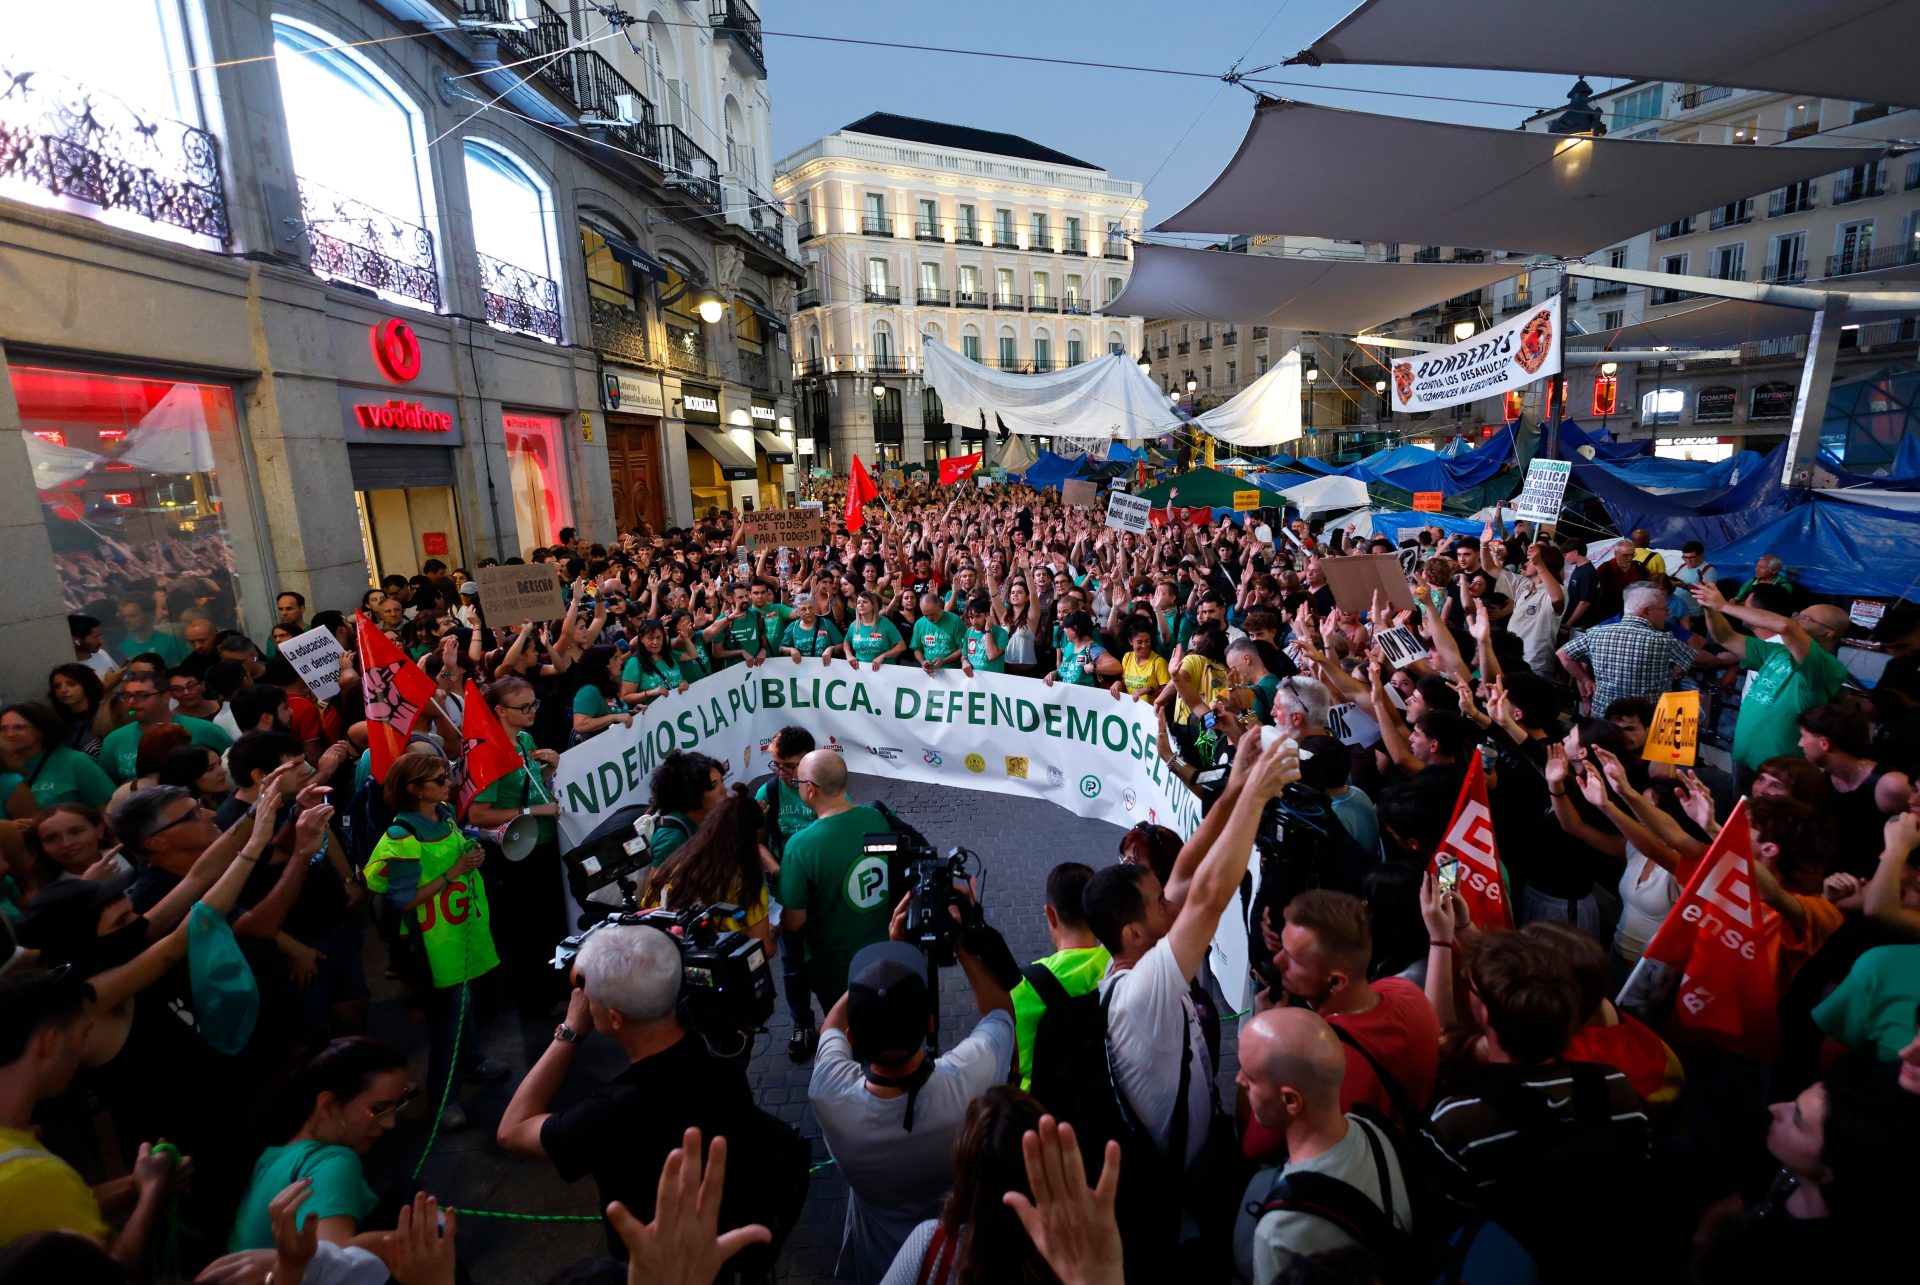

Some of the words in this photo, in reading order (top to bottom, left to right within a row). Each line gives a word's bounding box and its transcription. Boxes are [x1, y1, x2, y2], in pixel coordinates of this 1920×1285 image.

[1417, 331, 1515, 378] BOMBERXS
[1416, 379, 1444, 391] CONTRA
[1444, 374, 1459, 386] LOS
[1460, 385, 1470, 395] NI
[684, 395, 717, 413] RODILLA
[354, 401, 453, 432] vodafone
[751, 406, 776, 420] RODILLA
[1674, 437, 1718, 445] CARCASAS
[1533, 480, 1564, 492] CALIDAD
[1520, 495, 1559, 507] FEMINISTA
[1519, 503, 1533, 511] PARA
[1536, 505, 1558, 515] TODAS
[757, 523, 769, 531] DE
[773, 520, 808, 530] TOD@S
[753, 532, 777, 545] PARA
[780, 530, 817, 541] TOD@S!!
[516, 578, 554, 594] DERECHO
[284, 650, 298, 661] La
[294, 635, 335, 657] educación,
[299, 664, 312, 674] un
[311, 651, 340, 669] derecho
[308, 679, 321, 690] no
[558, 711, 699, 813] NDEMOS
[697, 697, 729, 739] LA
[728, 671, 882, 722] PÚBLICA.
[895, 687, 1143, 761] DEFENDEMOS
[1144, 733, 1162, 787] EL
[1434, 851, 1502, 905] ense
